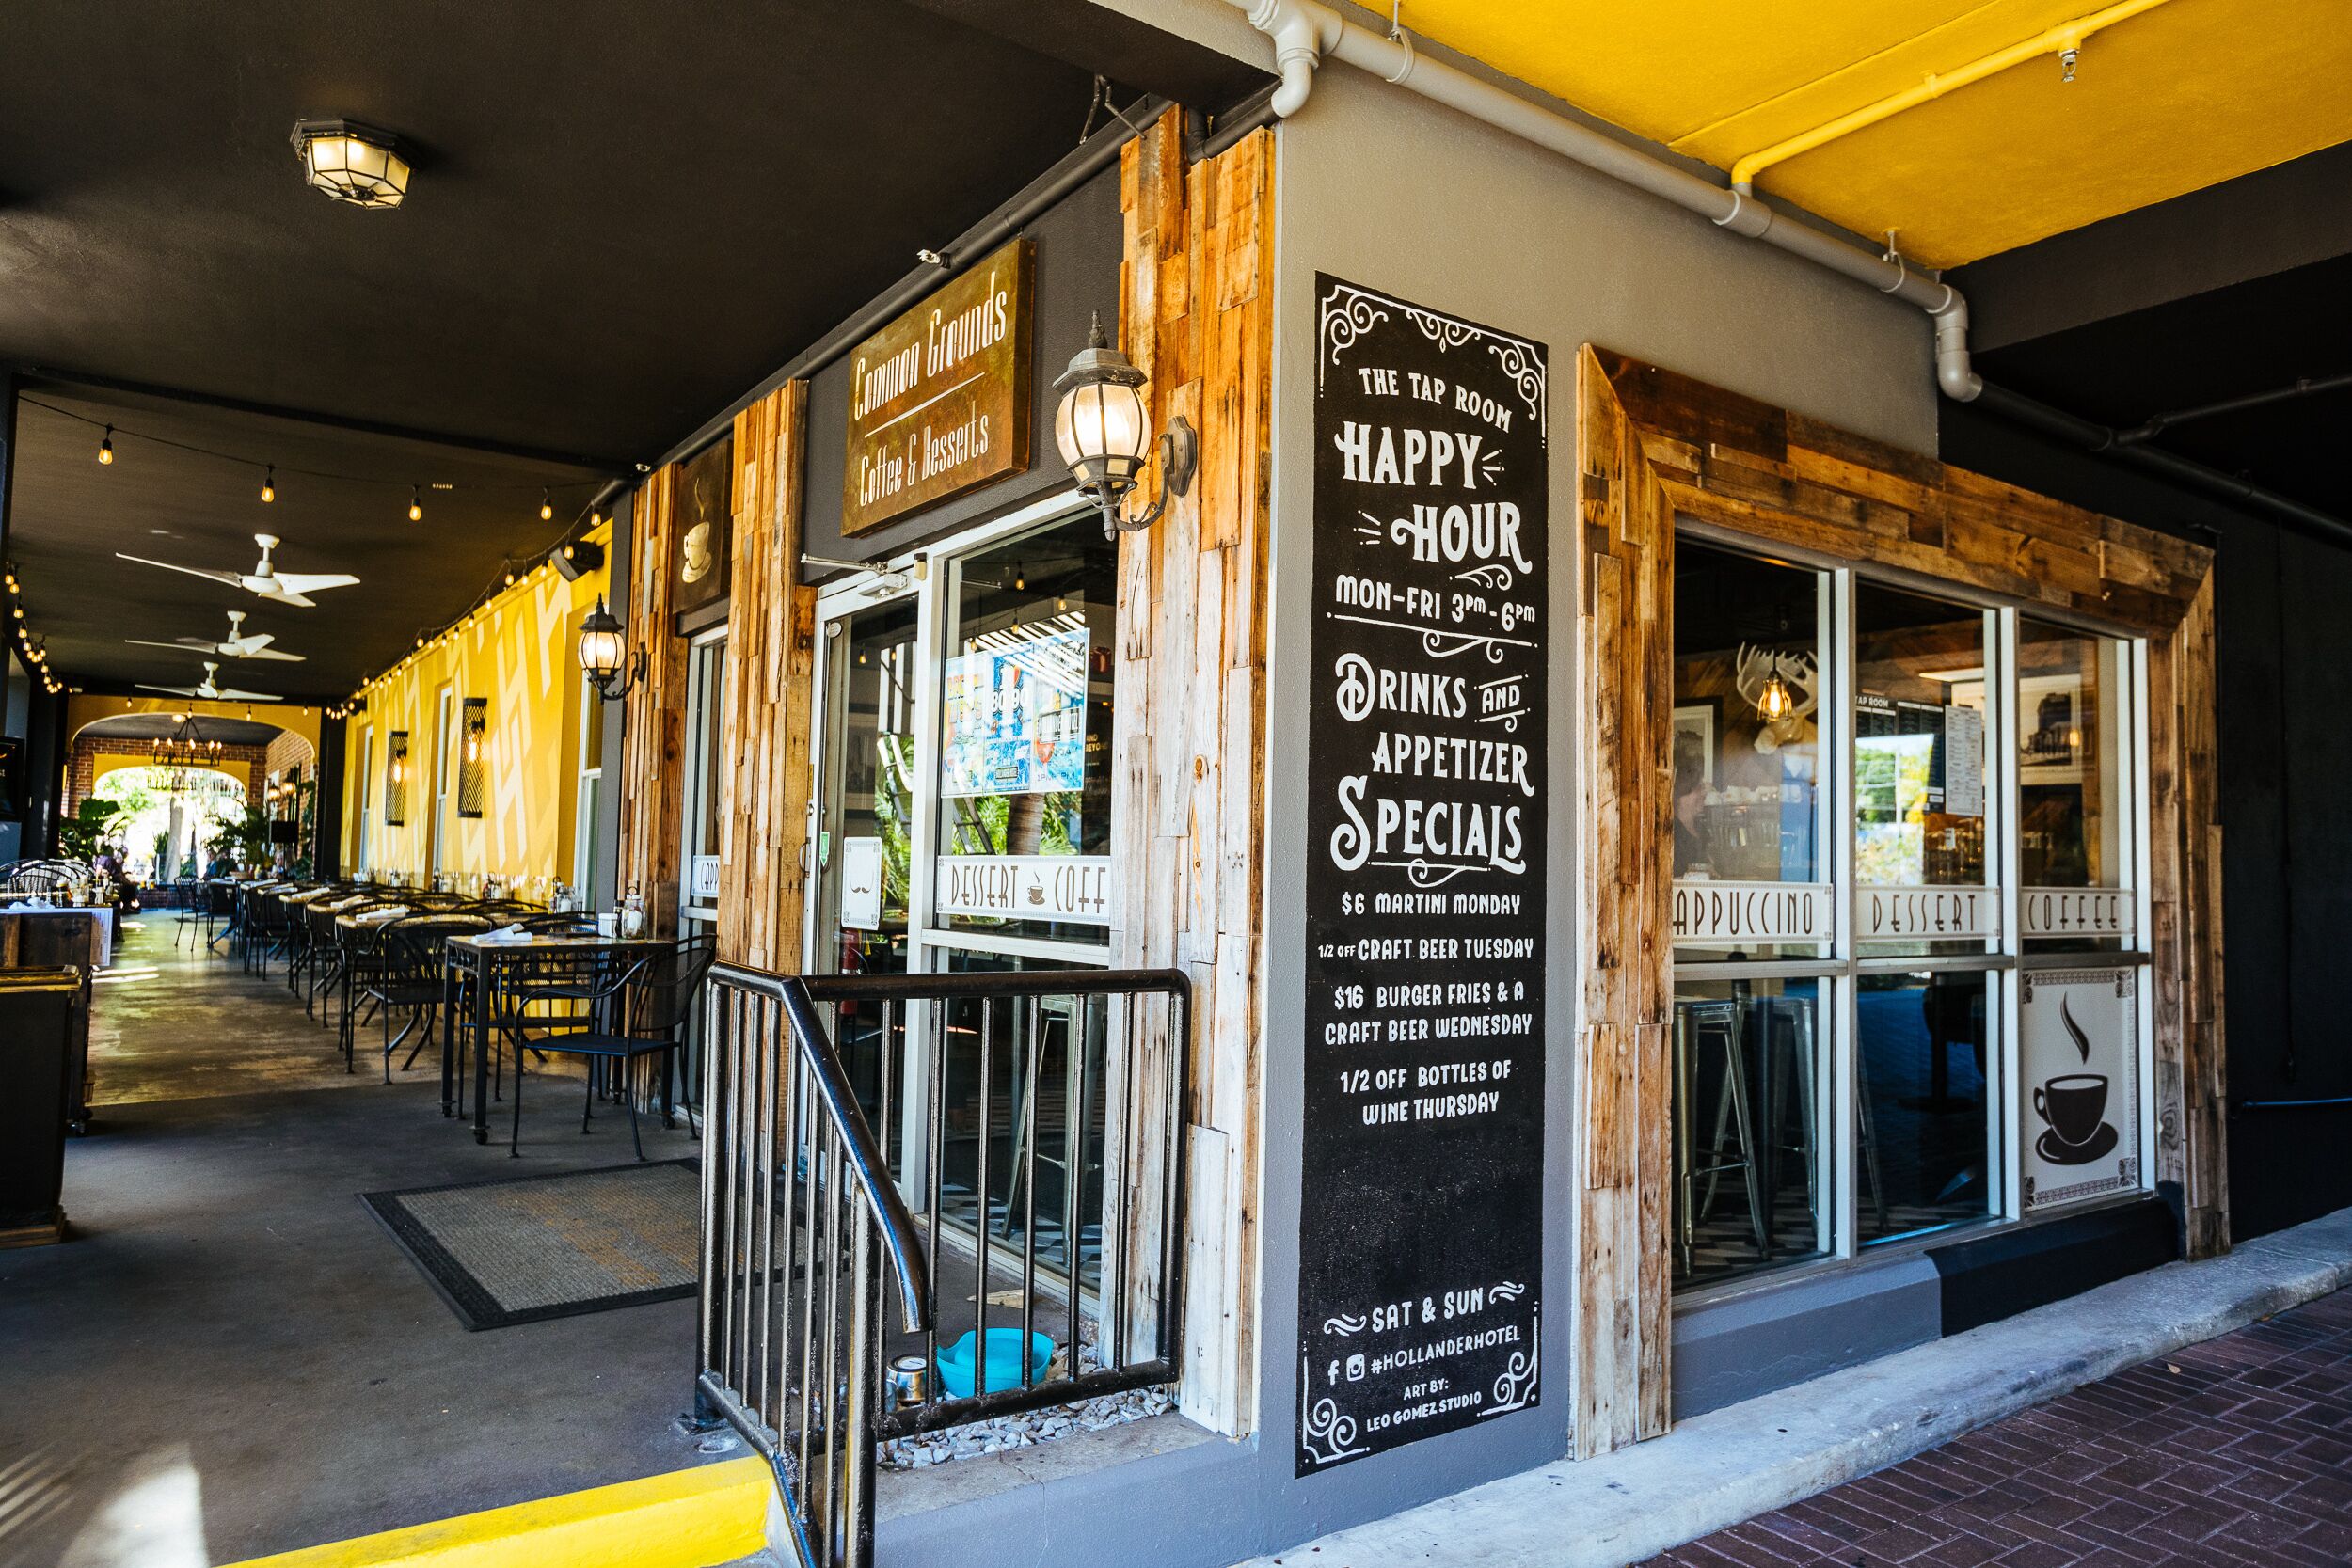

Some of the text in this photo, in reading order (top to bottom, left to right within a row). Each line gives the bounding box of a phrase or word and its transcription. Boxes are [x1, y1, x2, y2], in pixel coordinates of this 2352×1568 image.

[854, 271, 1008, 421] Common Grounds
[1359, 368, 1512, 433] THE TAP ROOM
[859, 400, 989, 507] Coffee & Desserts
[1334, 421, 1483, 489] HAPPY
[1391, 502, 1533, 574] HOUR
[1335, 574, 1441, 620] MON-FRI
[1334, 653, 1520, 721] DRINKS AND
[1868, 697, 1889, 708] ROOM
[1372, 731, 1534, 797] APPETIZER
[1330, 775, 1526, 875] SPECIALS
[700, 862, 720, 891] CAPP
[951, 864, 1106, 913] DESSERT COFF
[1342, 892, 1521, 915] $6 MARTINI MONDAY
[1672, 890, 2118, 936] APPUCCINO DESSERT COFFEE
[1317, 938, 1534, 960] 1/2 OFF CRAFT BEER TUESDAY
[1334, 981, 1524, 1009] $16 BURGER FRIES & A
[1325, 1014, 1533, 1045] CRAFT BEER WEDNESDAY
[1340, 1059, 1512, 1094] 1/2 OFF BOTTLES OF
[1362, 1091, 1500, 1125] WINE THURSDAY
[1372, 1287, 1484, 1333] SAT & SUN
[1370, 1325, 1521, 1374] #HOLLANDERHOTEL
[1366, 1391, 1483, 1432] LEO GOMEZ STUDIO
[1403, 1378, 1449, 1401] ART BY:
